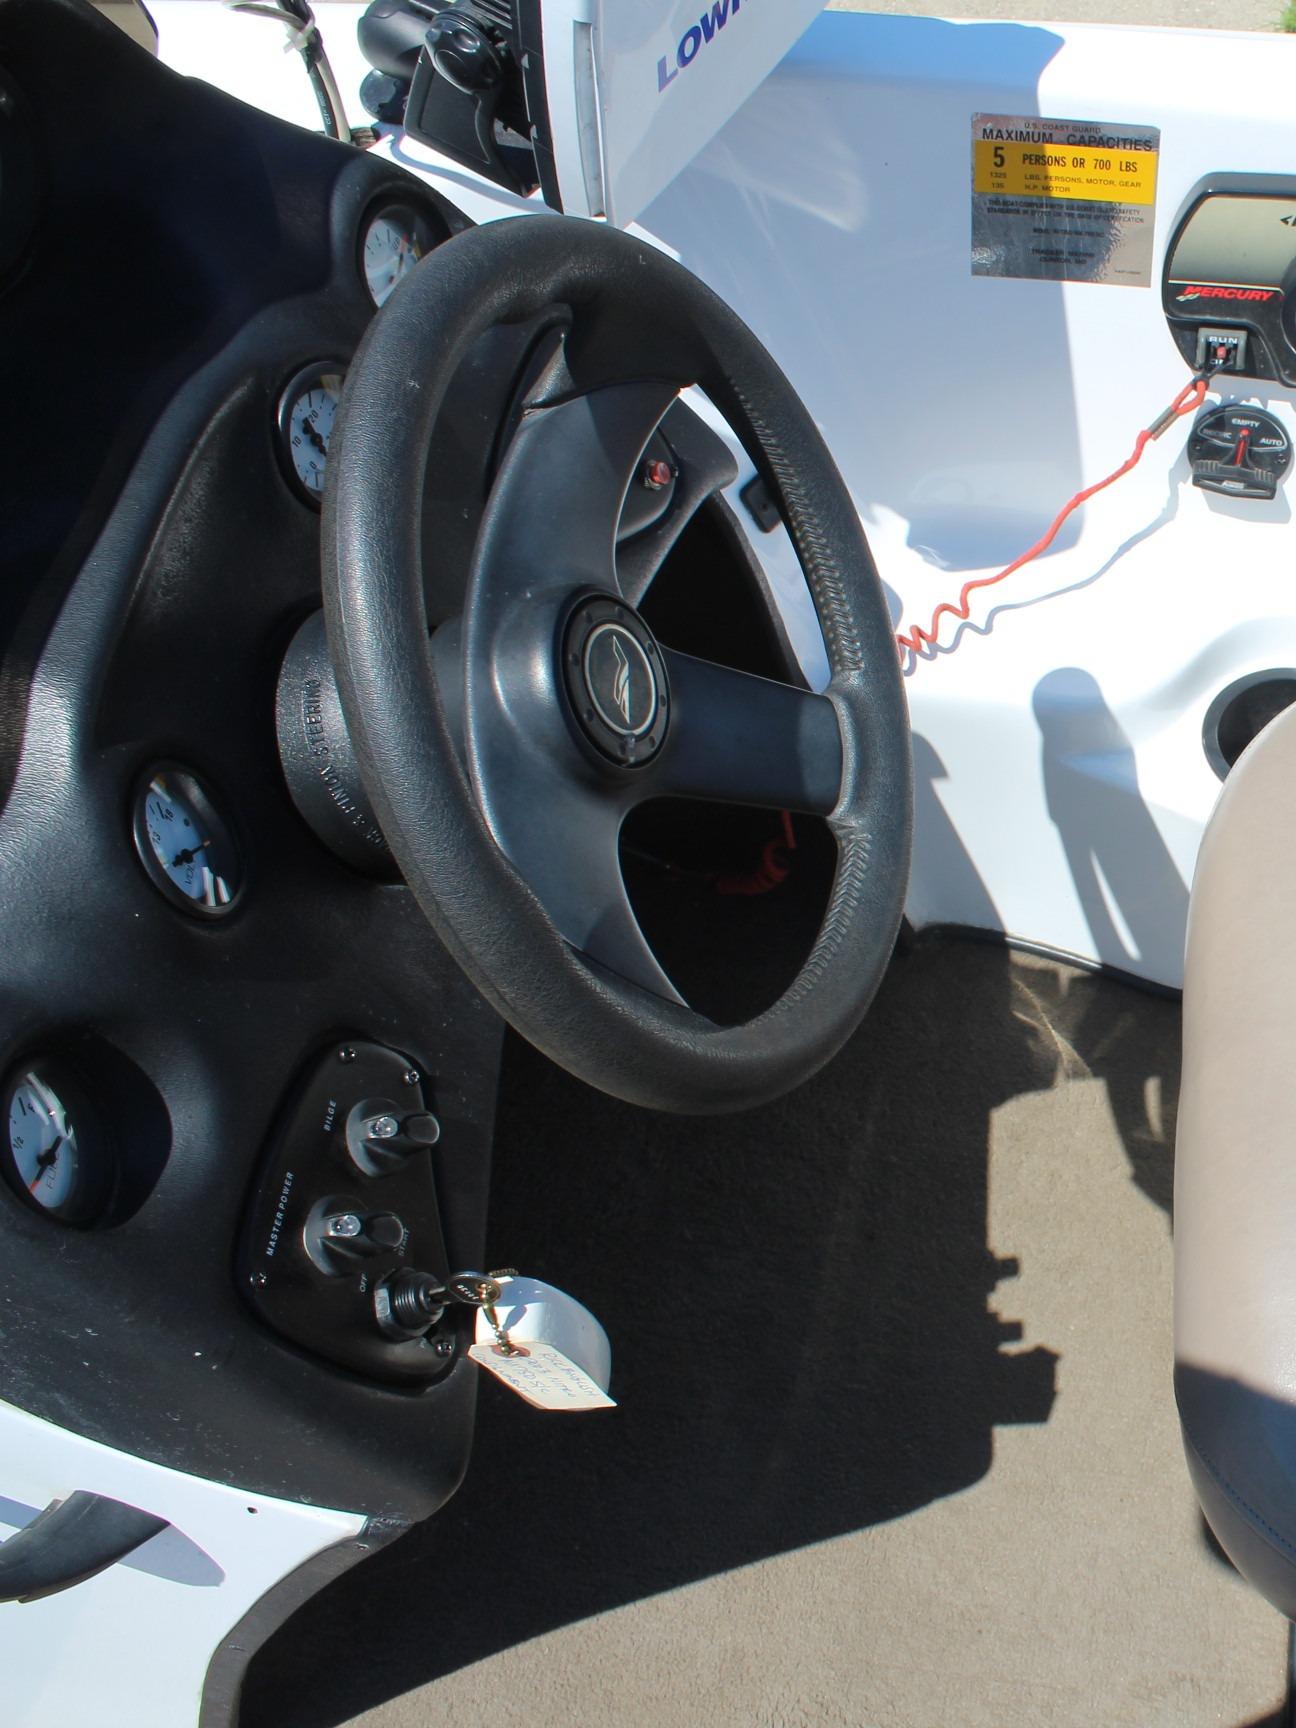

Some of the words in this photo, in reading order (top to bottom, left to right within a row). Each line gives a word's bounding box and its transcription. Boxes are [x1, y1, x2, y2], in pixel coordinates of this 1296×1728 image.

[1042, 124, 1070, 132] COAST
[1072, 125, 1101, 133] GUARD
[982, 128, 1053, 144] MAXIMUM
[1066, 134, 1153, 152] CAPACITIES
[993, 146, 1005, 168] 5
[1022, 153, 1066, 168] PERSONS
[1072, 157, 1085, 168] OR
[1093, 159, 1111, 170] 700
[1119, 162, 1138, 172] LBS
[1184, 285, 1274, 302] MERCURY
[1208, 335, 1238, 345] RUN
[1231, 417, 1260, 428] EMPTY
[291, 435, 302, 448] 10
[1259, 437, 1283, 447] AUTO
[304, 678, 329, 756] STEERING
[323, 1099, 337, 1133] BILGE
[265, 1210, 286, 1258] MASTER
[278, 1170, 295, 1212] POWER
[358, 1272, 368, 1294] OFF
